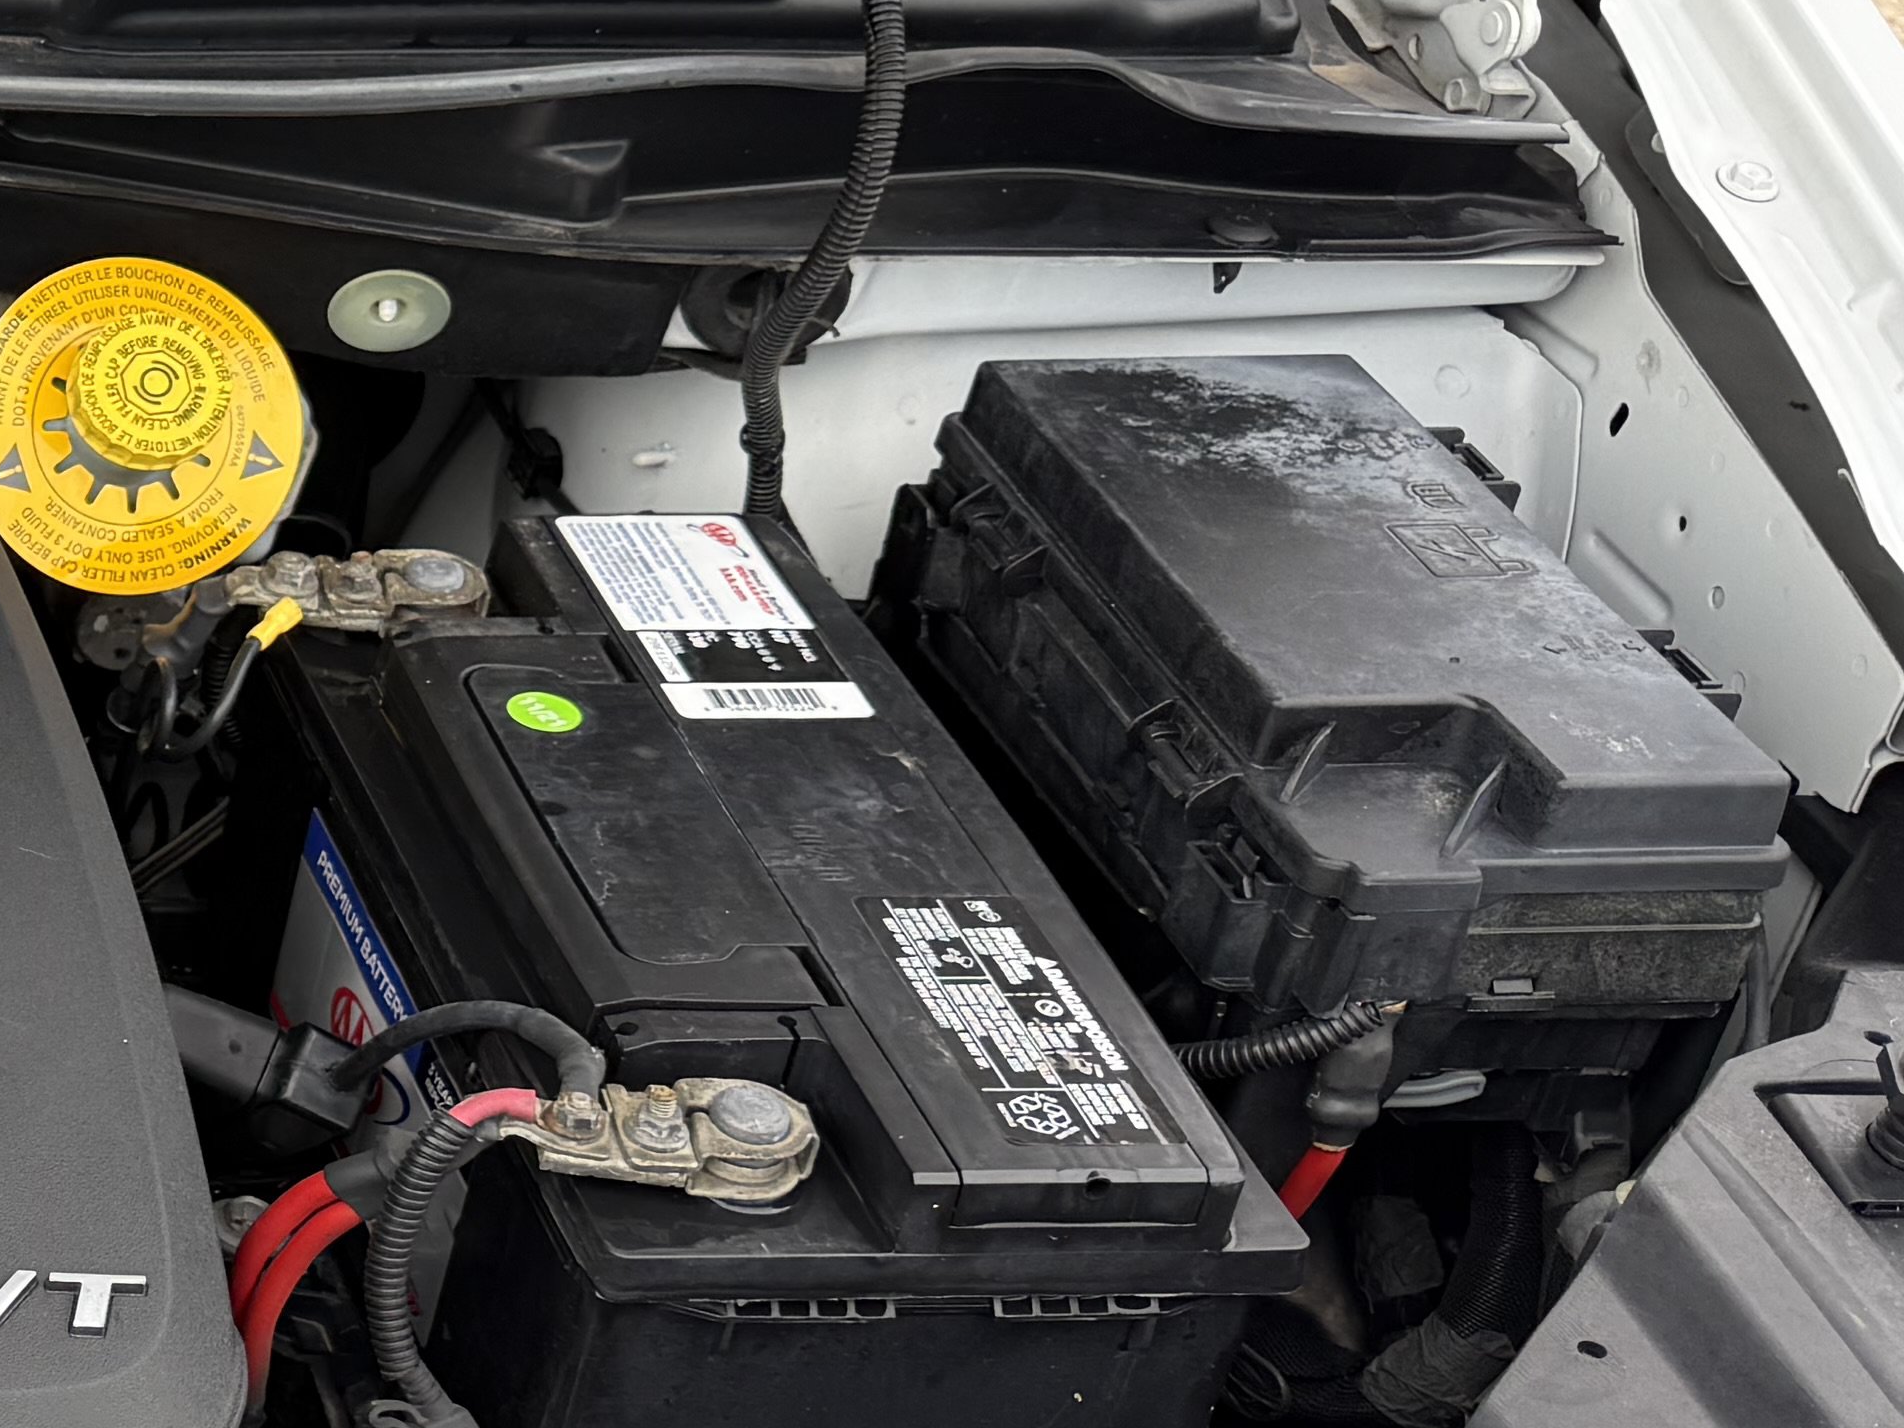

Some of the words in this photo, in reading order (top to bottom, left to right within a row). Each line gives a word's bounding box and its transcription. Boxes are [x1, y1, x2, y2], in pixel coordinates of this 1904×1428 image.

[31, 271, 94, 308] NETTOYER
[97, 267, 112, 280] LE
[115, 266, 184, 290] BOUCHON
[187, 283, 207, 300] DE
[206, 295, 275, 372] REMPLISSAGE
[81, 306, 115, 324] D'UN
[177, 320, 194, 335] DE
[1, 357, 18, 376] DE
[12, 338, 29, 357] LE
[72, 285, 130, 306] UTILISER
[134, 287, 221, 332] UNIQUEMENT
[219, 329, 239, 349] DU
[234, 349, 266, 403] LIQUIDE
[22, 316, 79, 383] PROVENANT
[17, 384, 29, 395] 3
[12, 397, 26, 427] DOT
[187, 487, 224, 523] FROM
[21, 507, 55, 541] FLUID
[45, 495, 117, 542] CONTAINER.
[176, 516, 186, 529] A
[8, 519, 52, 560] BEFORE
[54, 534, 65, 546] 3
[122, 523, 175, 542] SEALED
[64, 542, 93, 559] DOT
[179, 517, 252, 569] WARNING:
[52, 555, 78, 574] CAP
[95, 549, 133, 564] ONLY
[138, 547, 165, 564] USE
[81, 565, 125, 583] FILLER
[130, 562, 175, 582] CLEAN
[316, 849, 365, 944] PREMIUM
